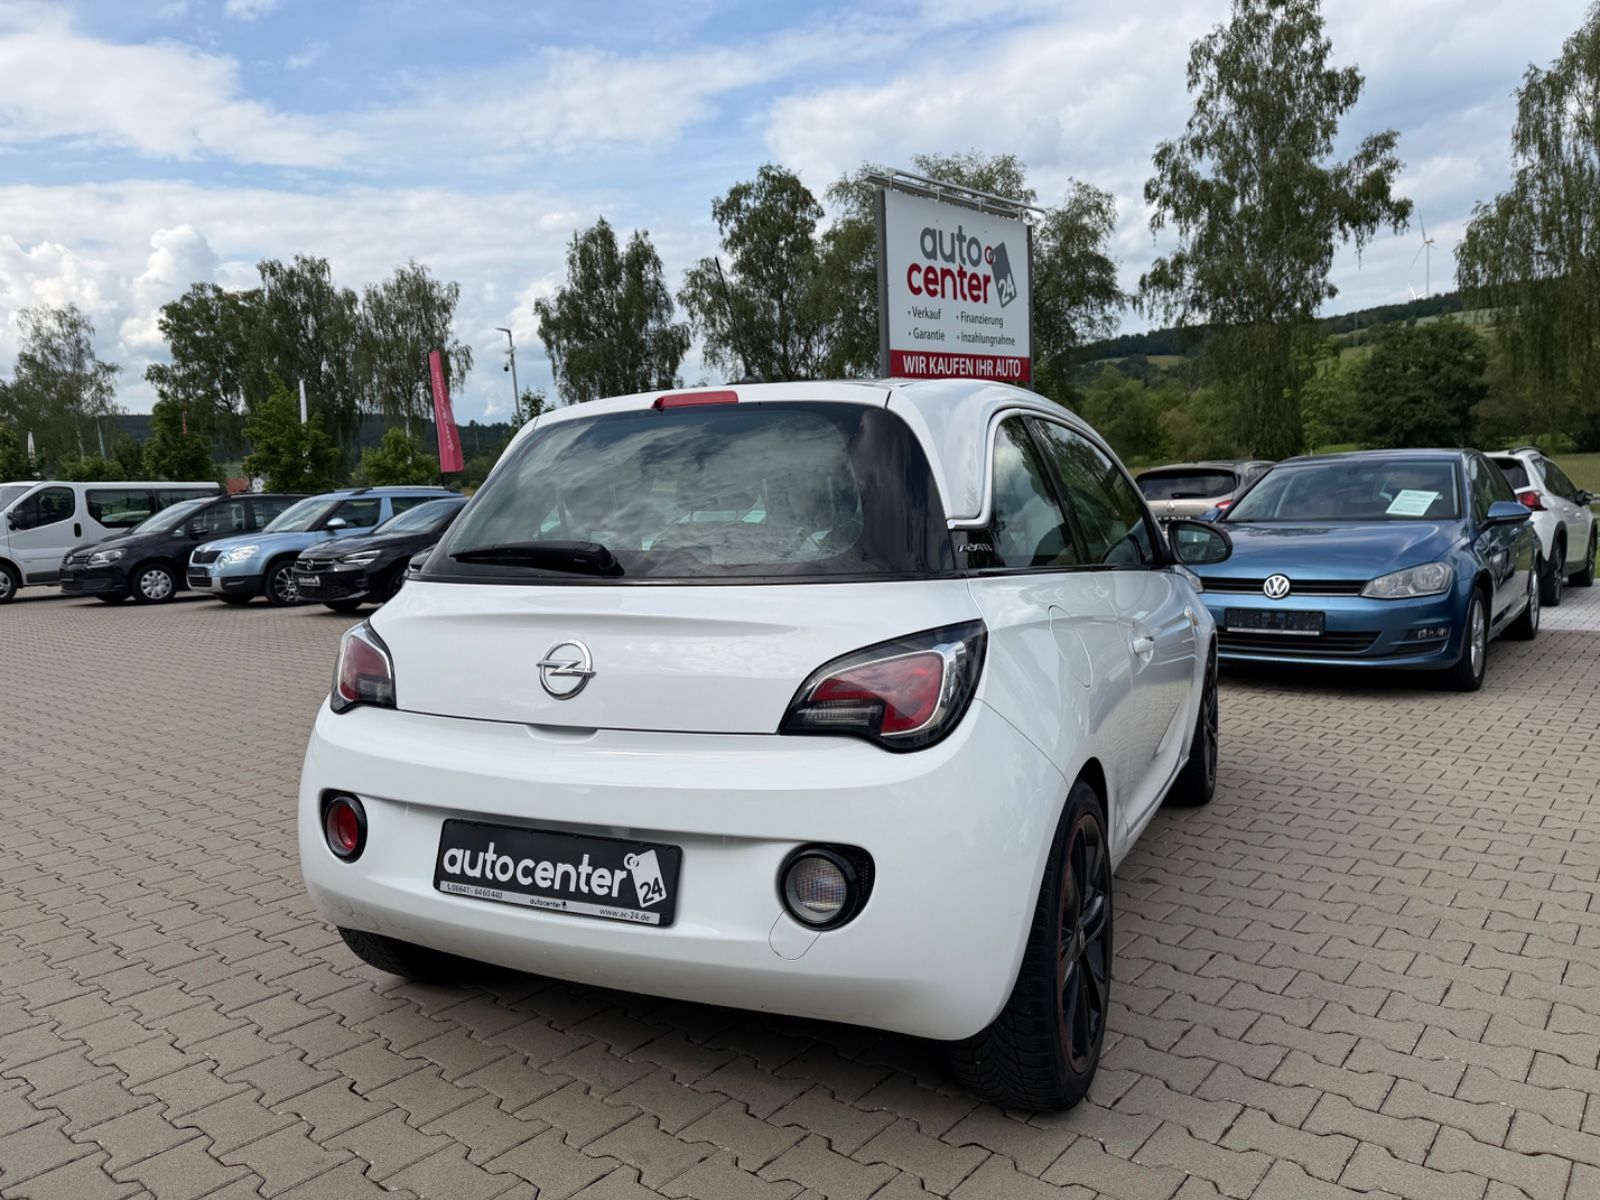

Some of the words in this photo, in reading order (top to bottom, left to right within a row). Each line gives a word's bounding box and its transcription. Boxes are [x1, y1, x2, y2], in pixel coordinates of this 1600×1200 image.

[920, 225, 982, 267] auto
[907, 263, 991, 304] center
[998, 273, 1015, 303] 24
[912, 307, 941, 320] Verkauf
[961, 312, 1004, 328] Finanzierung
[913, 328, 945, 341] Garantie
[961, 333, 1016, 347] Inzahlungnahme
[903, 355, 927, 374] WIR
[930, 356, 973, 376] KAUFEN
[976, 358, 993, 376] IHR
[995, 359, 1021, 377] AUTO
[443, 842, 627, 898] autocenter
[639, 877, 663, 905] 24
[599, 908, 650, 921] www.ac-24.de
